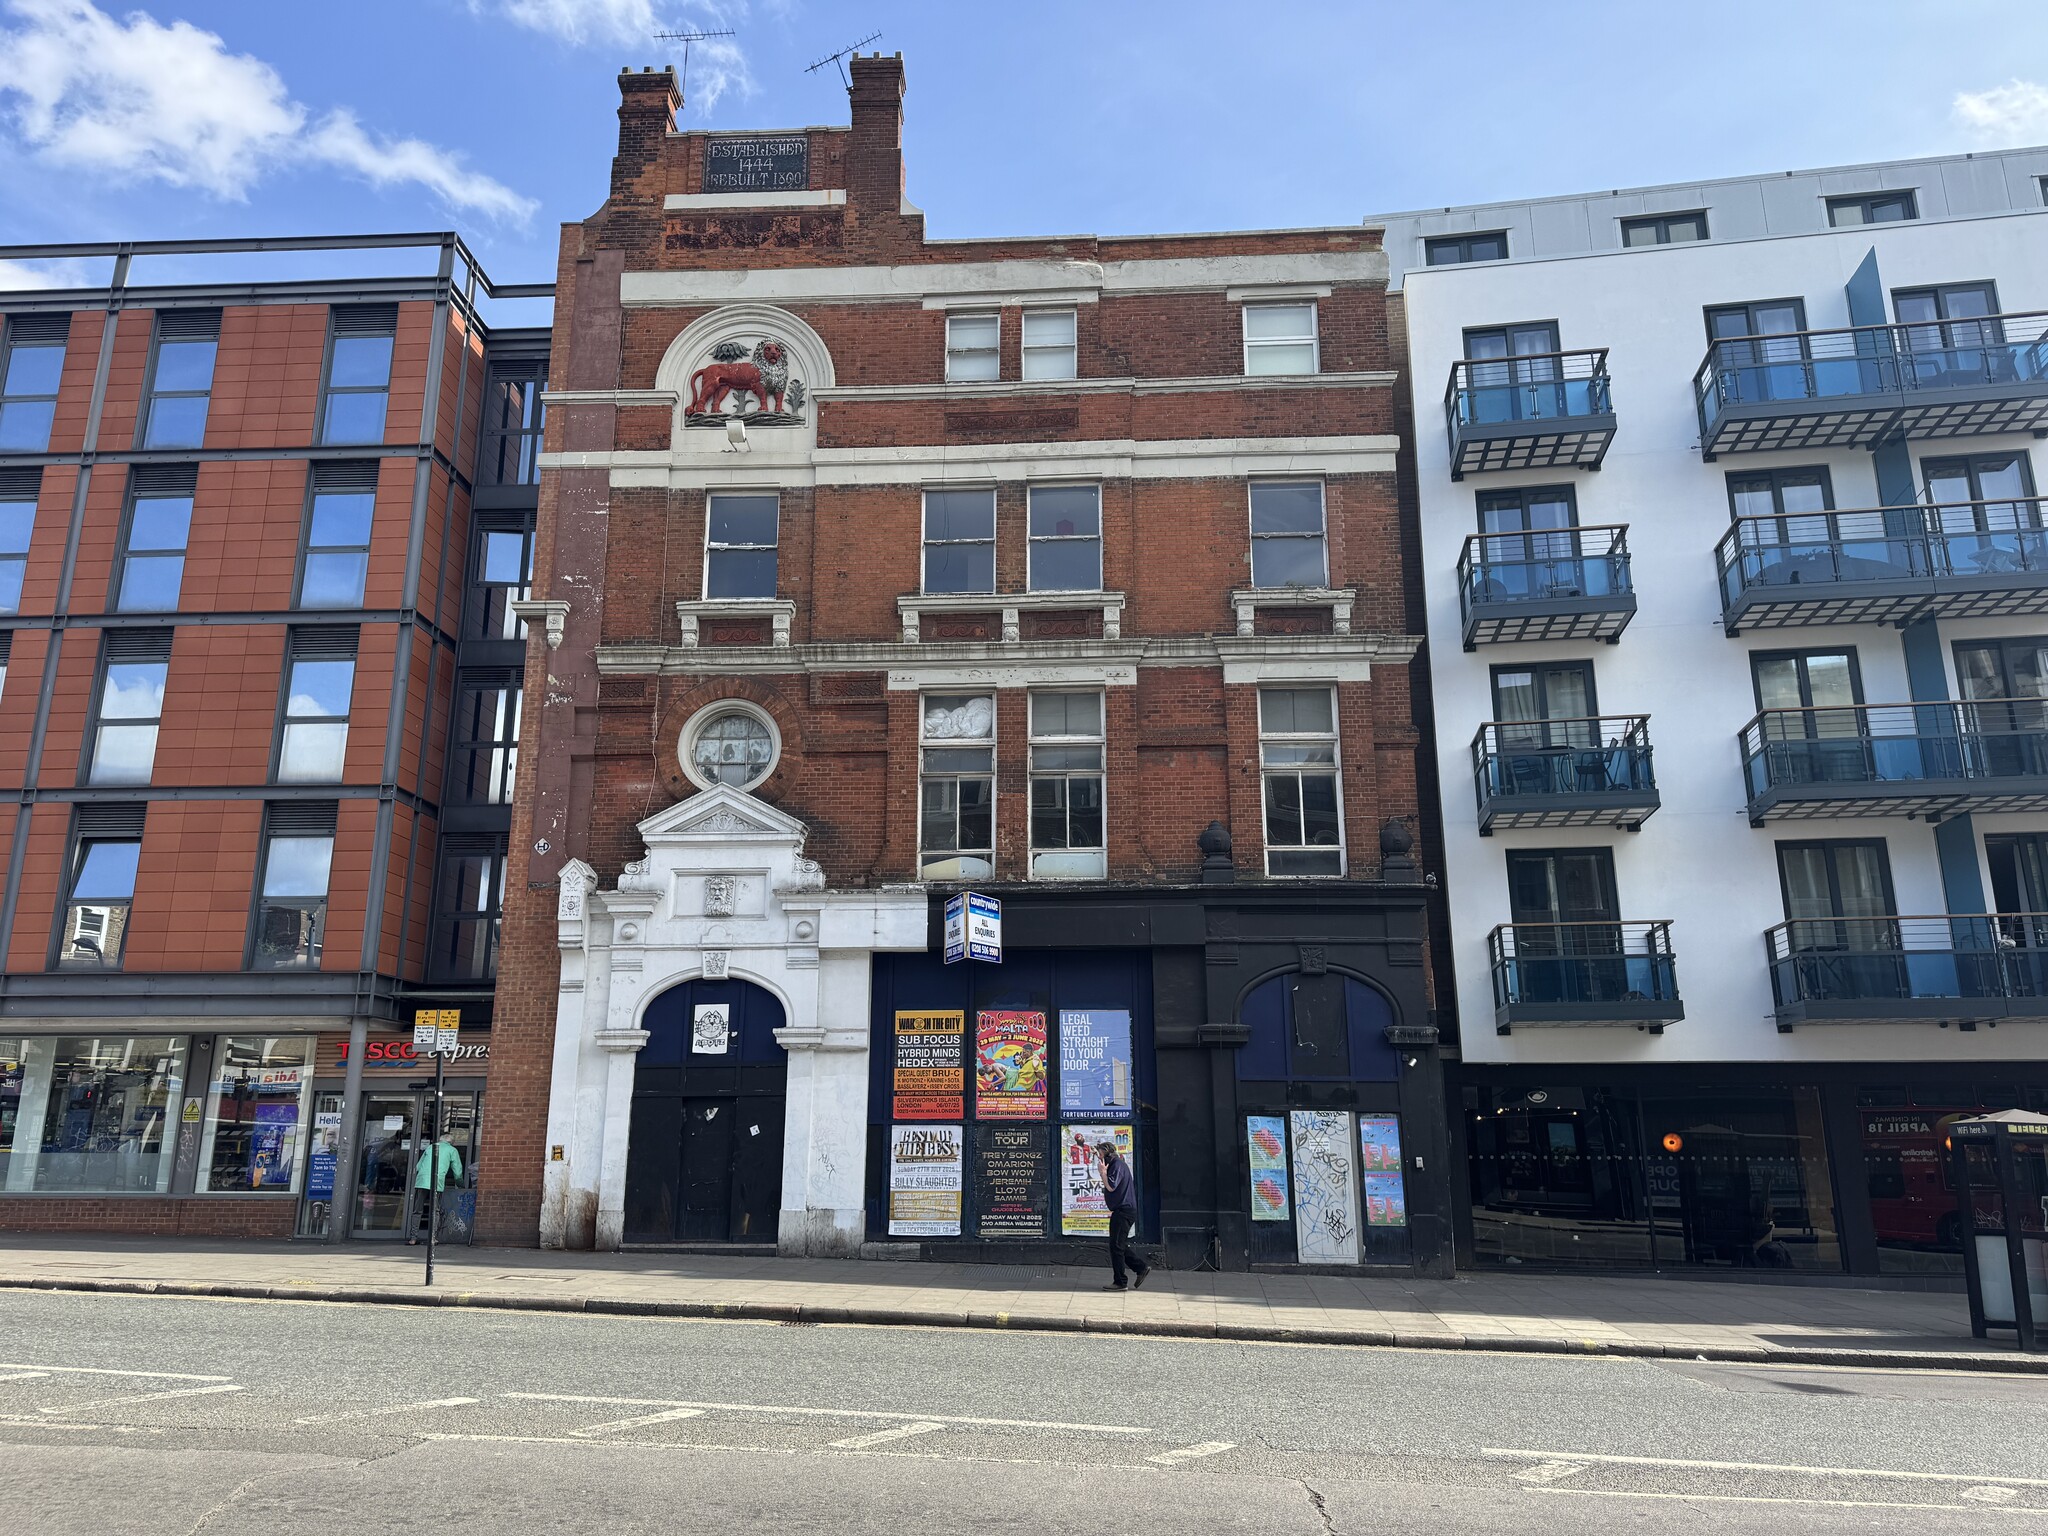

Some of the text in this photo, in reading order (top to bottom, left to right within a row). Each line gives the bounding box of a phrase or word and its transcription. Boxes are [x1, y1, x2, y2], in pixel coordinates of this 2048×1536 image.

[711, 143, 803, 160] ESTABLISHED
[739, 158, 774, 172] 1444
[710, 172, 769, 186] REBUILT
[971, 897, 998, 911] countrywide
[974, 926, 996, 939] ENQUIRIES
[932, 1017, 944, 1030] THE
[944, 1017, 960, 1030] CITY
[1062, 1014, 1092, 1025] LEGAL
[995, 1024, 1029, 1034] MALTA
[1062, 1025, 1090, 1036] WEED
[898, 1035, 961, 1044] SUB FOCUS
[988, 1034, 1002, 1042] MAY
[1062, 1036, 1110, 1048] STRAIGHT
[897, 1048, 960, 1058] HYBRID MINDS
[1062, 1047, 1104, 1059] TO YOUR
[897, 1058, 935, 1068] HEDEX
[1063, 1059, 1090, 1071] DOOR
[1969, 1125, 1981, 1134] here
[995, 1136, 1029, 1145] TOUR
[1115, 1133, 1128, 1146] 06
[981, 1151, 1007, 1159] TREY
[987, 1160, 1034, 1168] OMARION
[894, 1177, 957, 1187] BILLY SLAUGHTER
